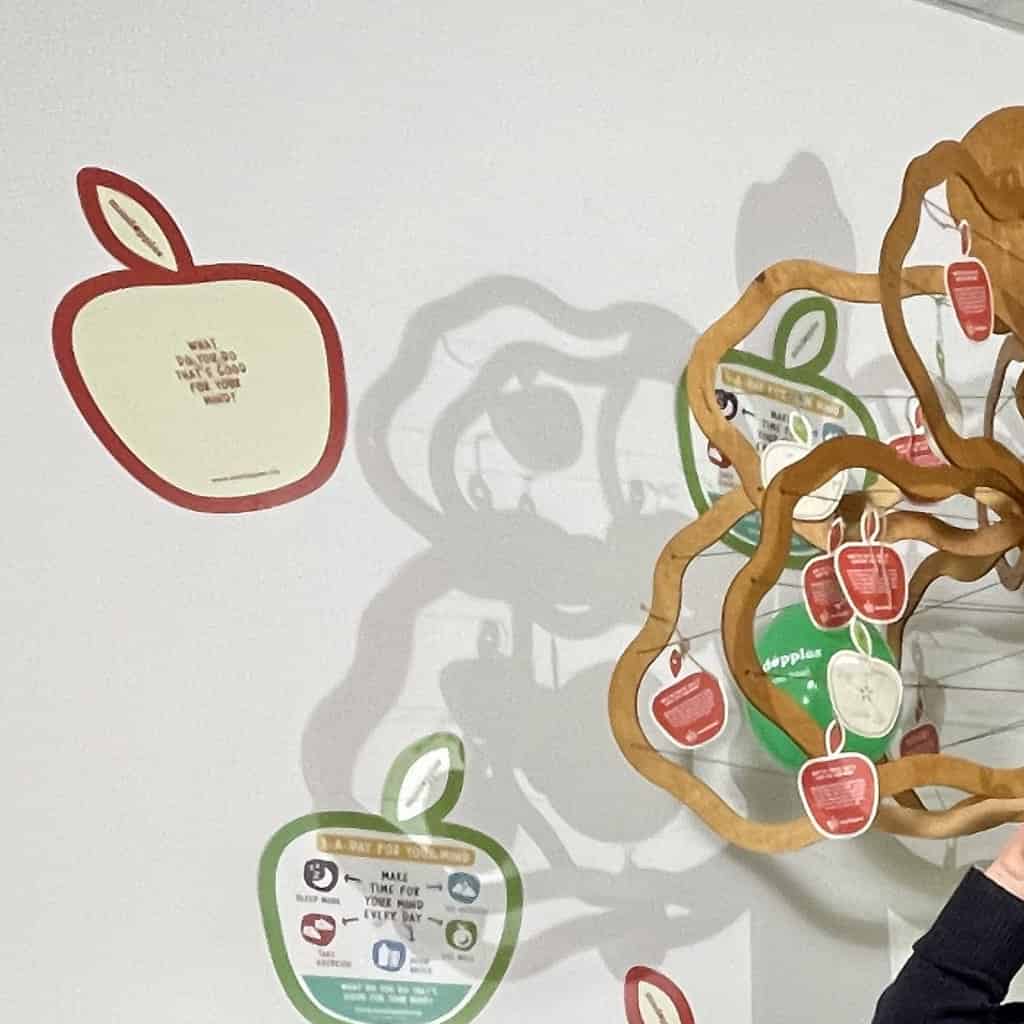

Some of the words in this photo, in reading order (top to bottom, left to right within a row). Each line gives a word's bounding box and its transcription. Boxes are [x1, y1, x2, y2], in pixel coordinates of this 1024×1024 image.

[381, 871, 409, 883] MAKE
[370, 882, 394, 894] TIME
[400, 884, 421, 897] FOR
[364, 895, 393, 908] YOUR
[397, 898, 424, 911] MIND
[364, 909, 397, 922] EVERY
[401, 910, 423, 922] DAY
